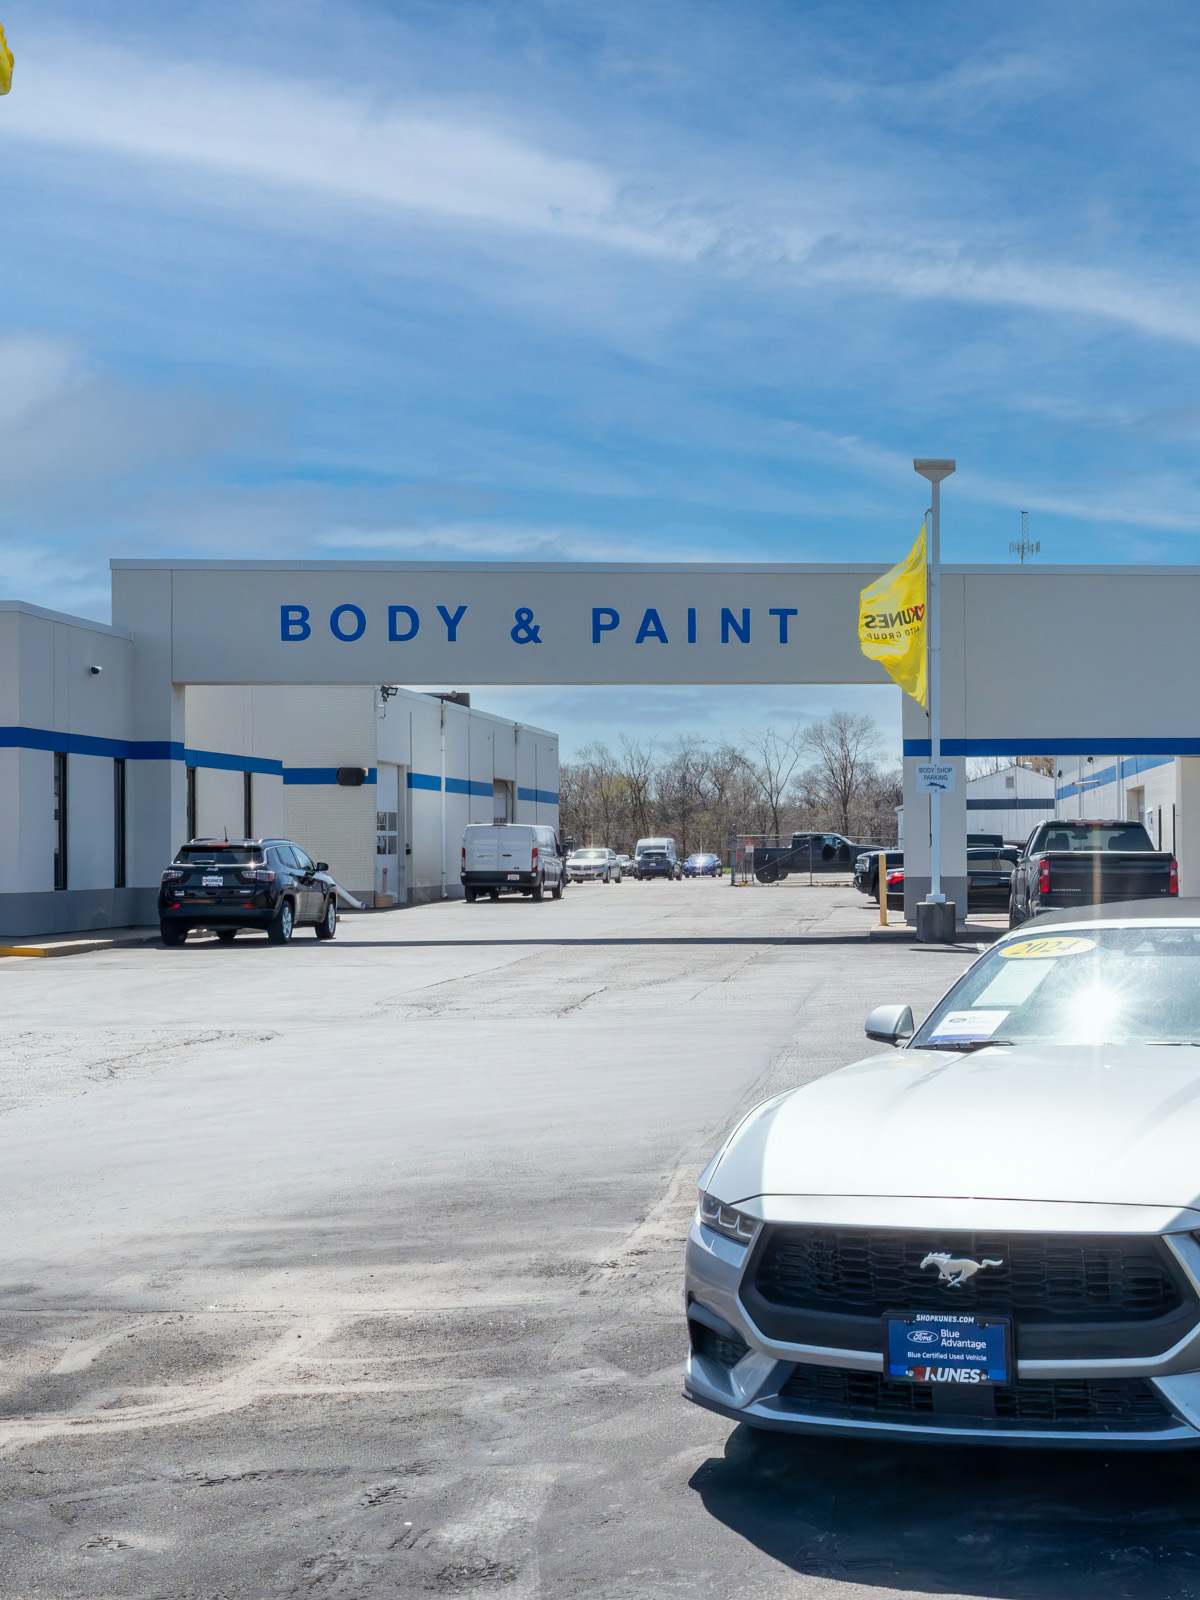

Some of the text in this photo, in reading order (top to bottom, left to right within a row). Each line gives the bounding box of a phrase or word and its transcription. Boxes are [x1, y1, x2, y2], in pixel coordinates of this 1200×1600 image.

[280, 604, 798, 644] BODY & PAINT
[1011, 940, 1081, 956] 2024
[916, 1314, 975, 1324] SHOPKUNES.COM
[940, 1329, 960, 1338] Blue
[940, 1338, 987, 1350] Advantage
[907, 1351, 921, 1359] Blue
[922, 1352, 948, 1360] Certified
[924, 1367, 981, 1384] KUNES
